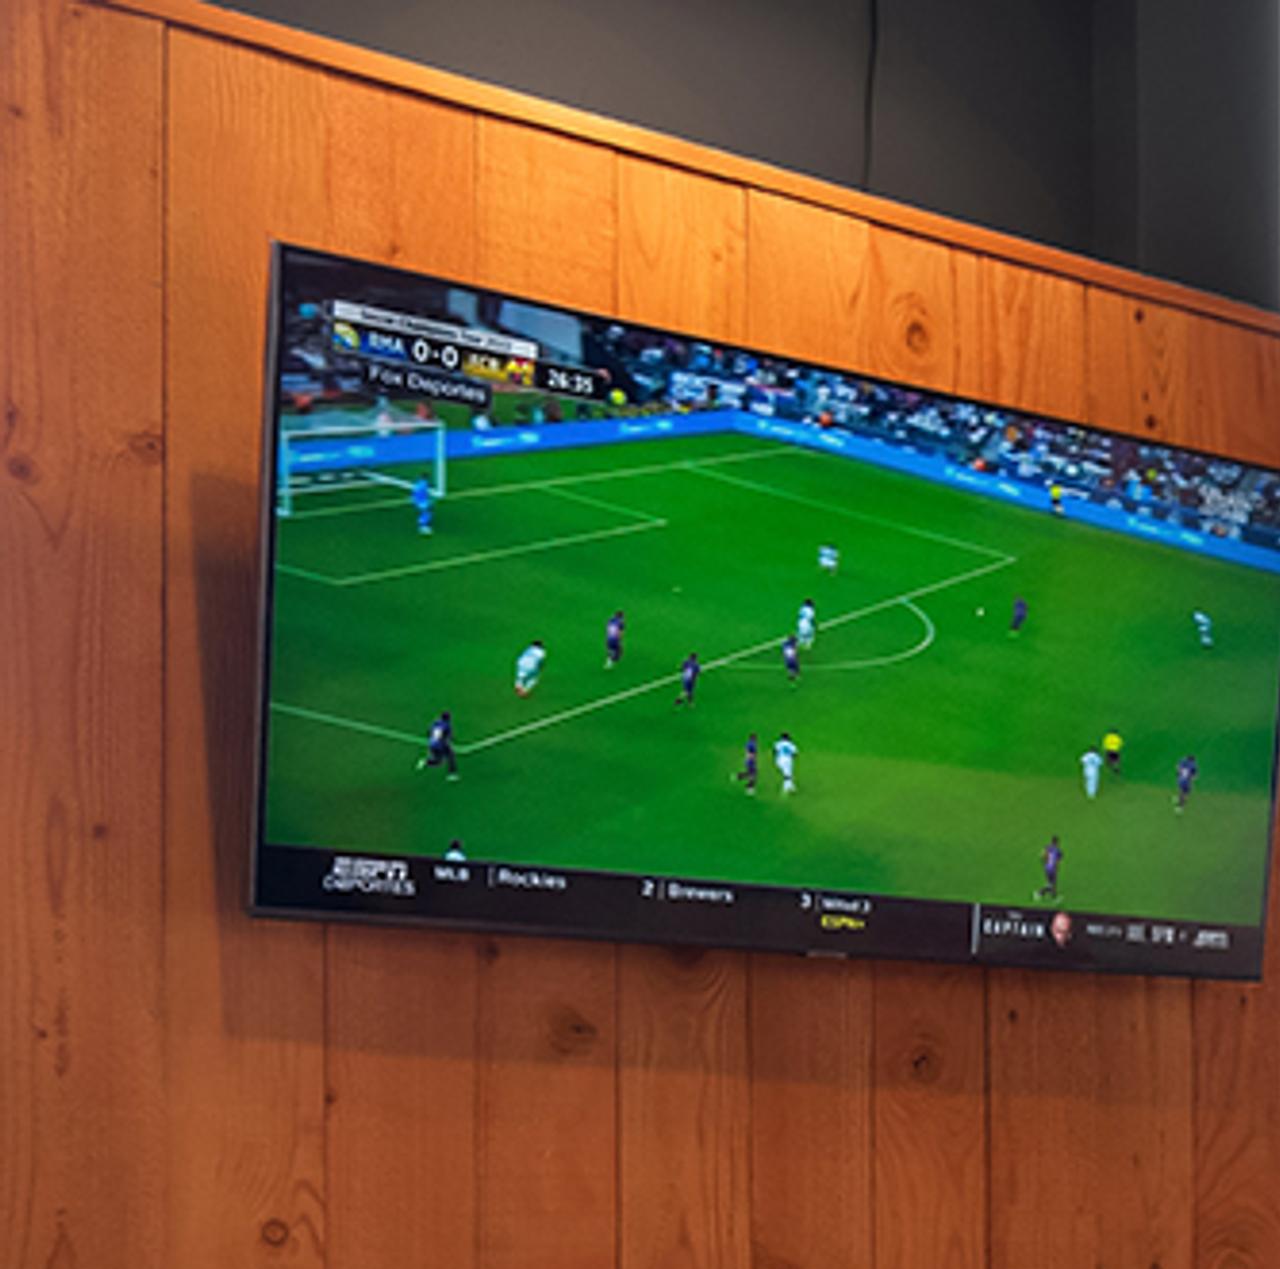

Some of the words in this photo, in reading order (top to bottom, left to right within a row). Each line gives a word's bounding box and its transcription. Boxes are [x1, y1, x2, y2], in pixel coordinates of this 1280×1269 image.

[369, 364, 401, 386] Fox
[407, 371, 486, 404] Deportes
[498, 866, 567, 890] Rockies
[668, 881, 735, 904] Brewers
